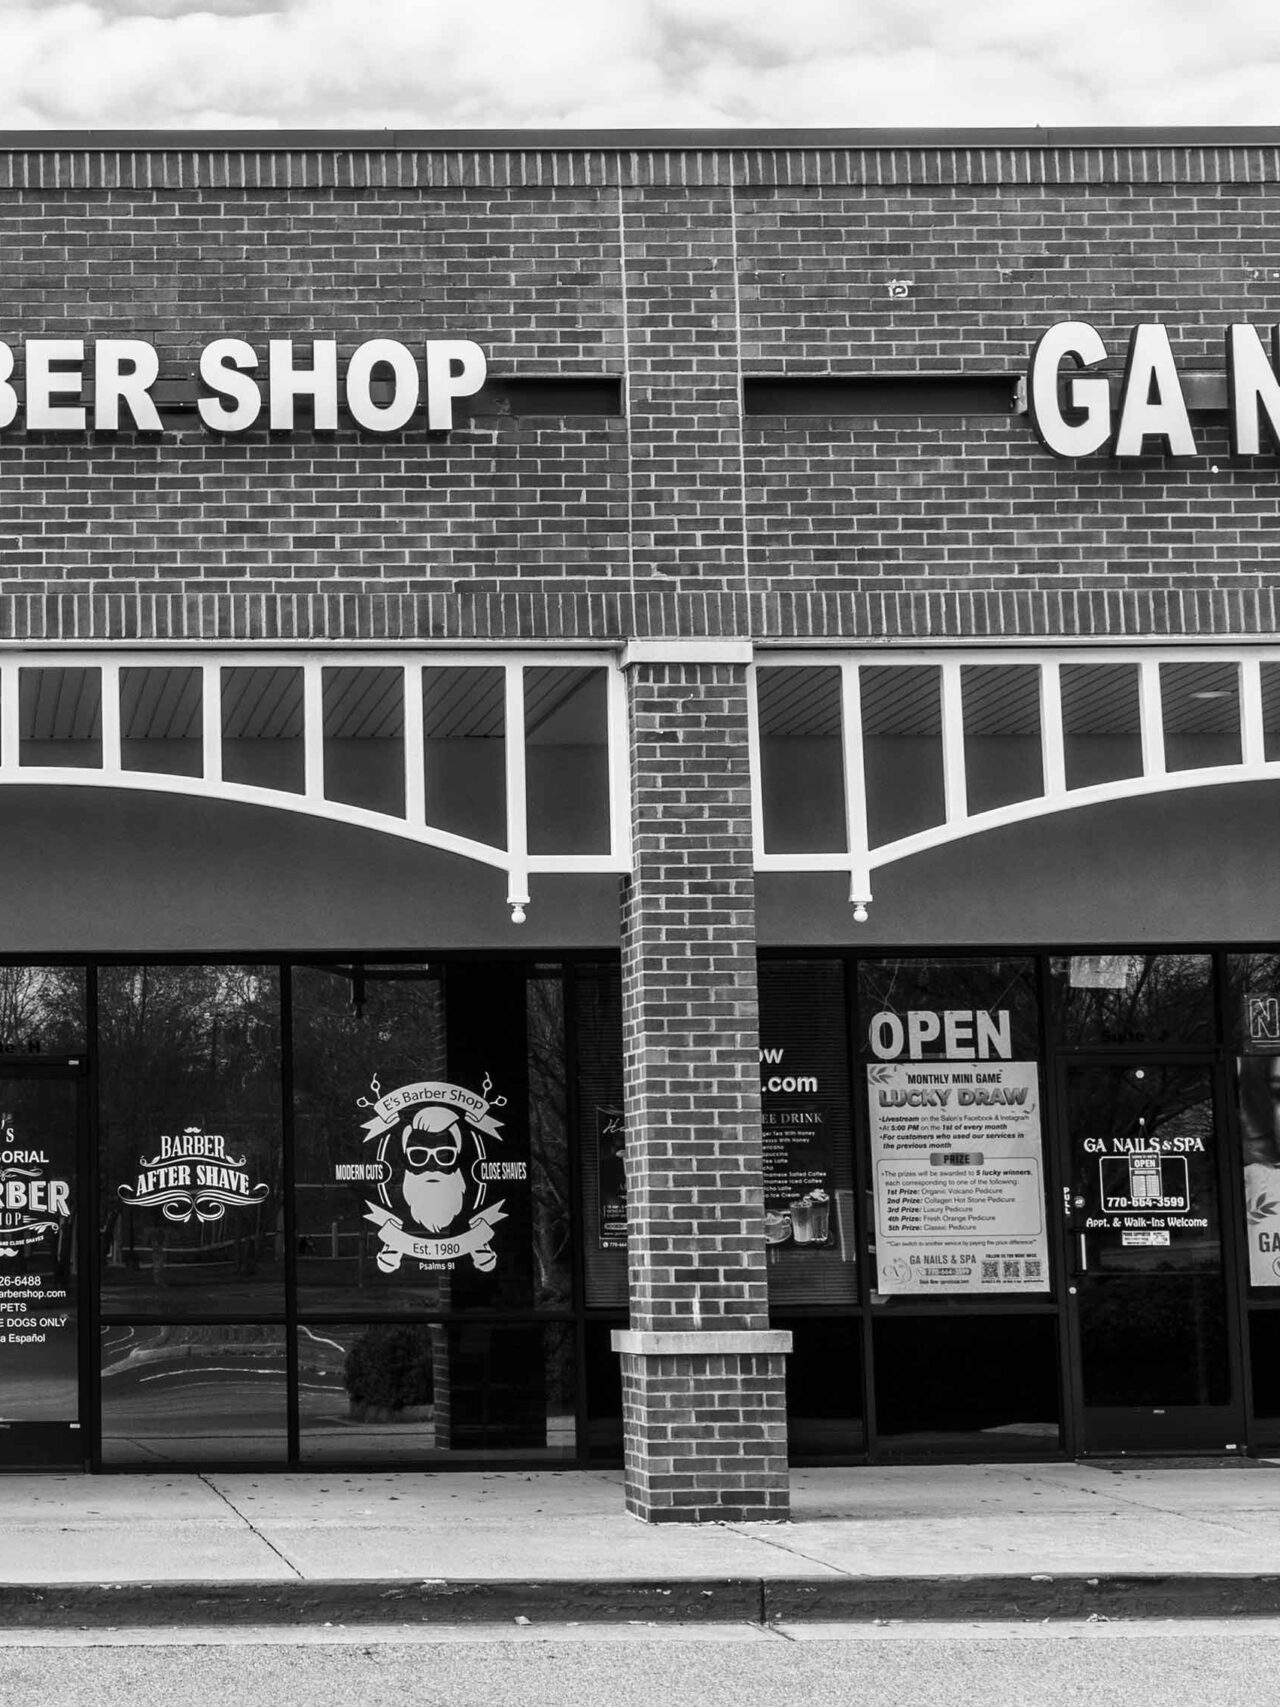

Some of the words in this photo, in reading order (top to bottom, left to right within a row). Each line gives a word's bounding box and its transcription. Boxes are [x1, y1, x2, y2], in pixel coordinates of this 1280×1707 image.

[197, 338, 488, 433] SHOP
[1031, 320, 1198, 457] GA
[869, 1010, 1012, 1060] OPEN
[28, 1041, 40, 1053] H
[907, 1073, 950, 1084] MONTHLY
[952, 1073, 973, 1084] MINI
[975, 1072, 1002, 1084] GAME
[383, 1097, 401, 1111] E's
[403, 1088, 445, 1103] Barber
[450, 1089, 484, 1111] Shop
[878, 1088, 952, 1108] LUCKY
[957, 1087, 1029, 1106] DRAW
[781, 1112, 823, 1124] DRINK
[161, 1135, 225, 1159] BARBER
[1083, 1137, 1107, 1152] GA
[1113, 1137, 1160, 1152] NAILS
[1162, 1140, 1172, 1151] &
[1173, 1137, 1205, 1151] SPA
[943, 1154, 970, 1164] PRIZE
[1134, 1159, 1156, 1168] OPEN
[335, 1165, 364, 1180] MODERN
[365, 1165, 384, 1180] CUTS
[481, 1163, 501, 1180] CLOSE
[502, 1162, 527, 1179] SHAVES
[982, 1169, 1001, 1177] lucky
[136, 1165, 191, 1197] AFTER
[196, 1165, 250, 1195] SHAVE
[921, 1188, 946, 1196] Organic
[1063, 1187, 1071, 1215] PULL
[923, 1206, 943, 1214] Luxury
[1086, 1217, 1110, 1228] Appt.
[1113, 1217, 1121, 1227] &
[1124, 1217, 1165, 1227] Walk-Ins
[1167, 1217, 1208, 1227] Welcome
[26, 1235, 44, 1244] SHAVES
[1258, 1231, 1280, 1253] GA
[413, 1243, 432, 1256] Est.
[435, 1243, 460, 1256] 1980
[910, 1255, 921, 1265] GA
[924, 1255, 948, 1264] NAILS
[951, 1255, 957, 1264] &
[960, 1254, 976, 1264] SPA
[419, 1262, 445, 1270] Psalms
[447, 1262, 454, 1270] 91
[0, 1303, 27, 1312] PETS
[7, 1318, 37, 1327] DOGS
[39, 1318, 67, 1327] ONLY
[9, 1333, 46, 1345] Español
